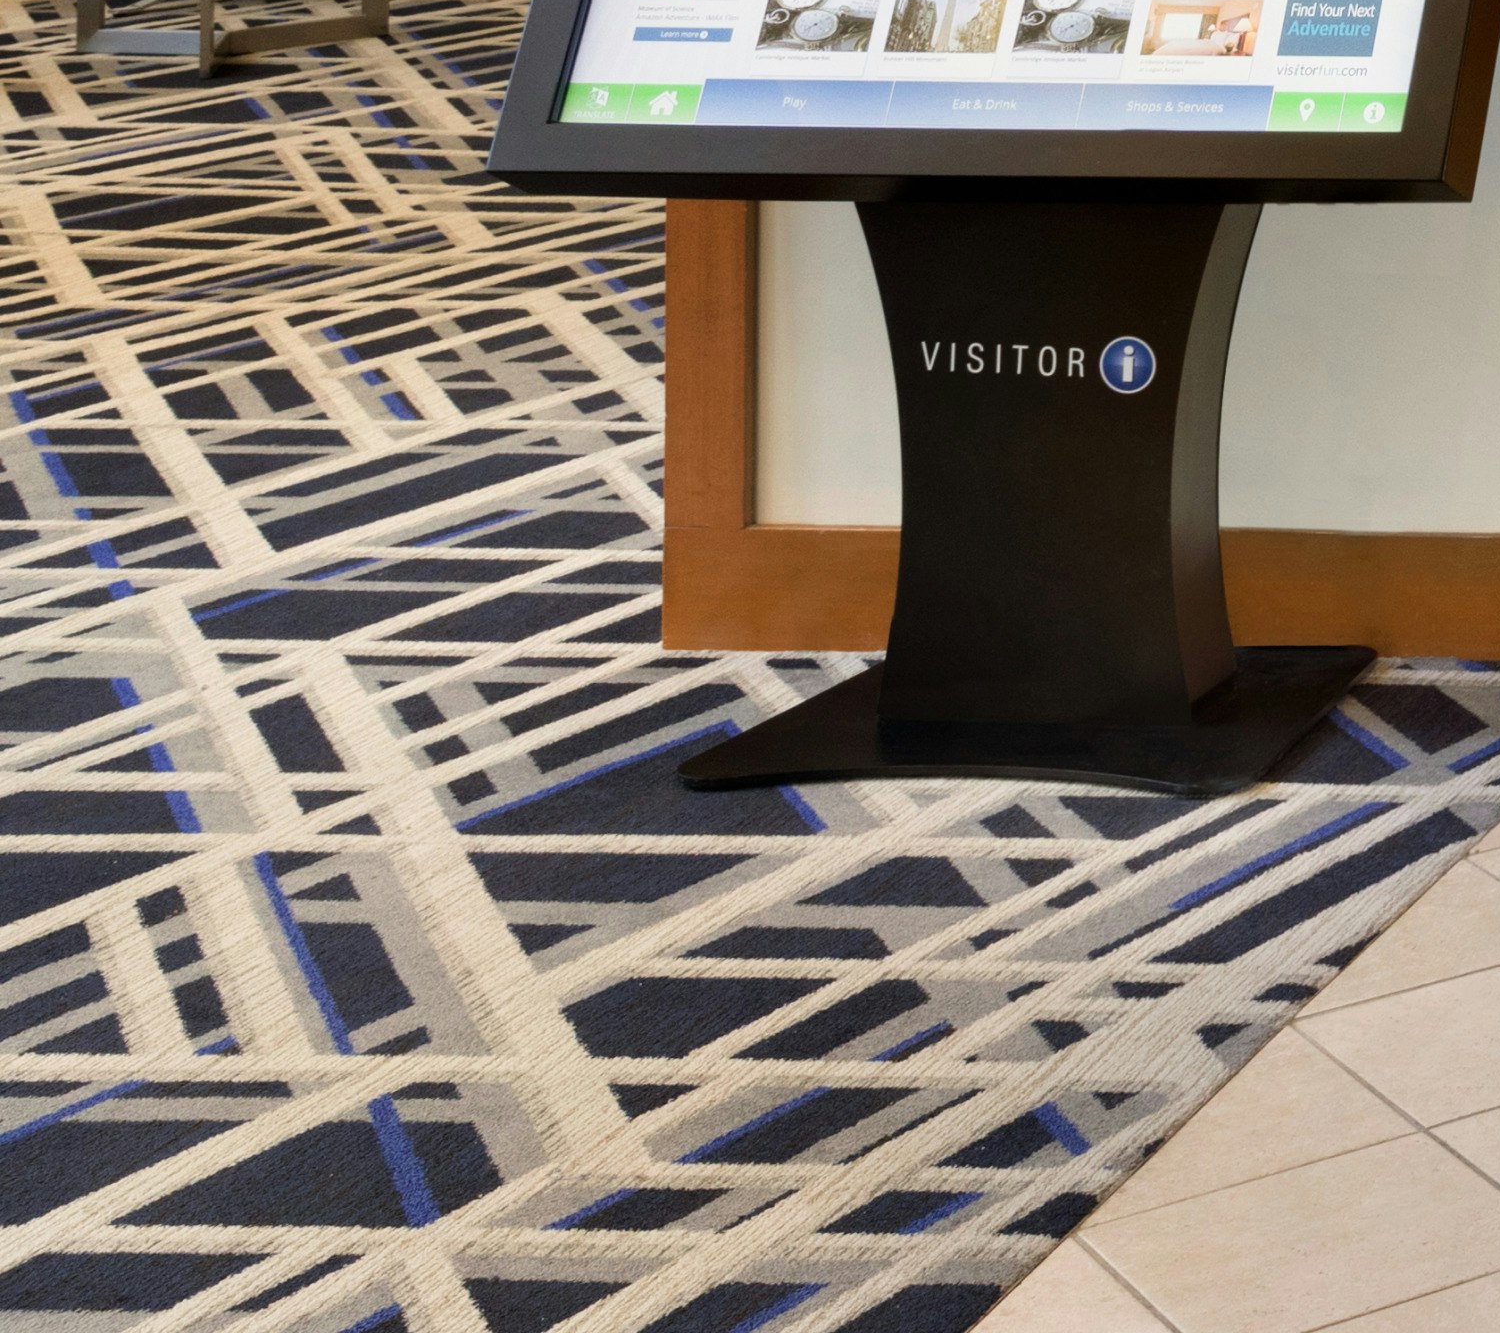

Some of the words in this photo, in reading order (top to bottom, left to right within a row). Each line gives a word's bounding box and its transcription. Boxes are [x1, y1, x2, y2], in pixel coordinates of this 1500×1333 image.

[1290, 2, 1317, 17] Find
[1319, 3, 1346, 18] Your
[1347, 4, 1376, 18] Next
[661, 31, 680, 39] Learn
[1287, 20, 1371, 37] Adventure
[1276, 63, 1368, 77] visitorfun.com
[782, 96, 808, 111] Play
[951, 98, 971, 110] Eat
[973, 98, 983, 110] &
[984, 98, 1018, 111] Drink
[1126, 100, 1163, 115] Shops
[1165, 101, 1174, 113] &
[1176, 102, 1224, 114] Services
[920, 340, 1085, 378] VISITOR
